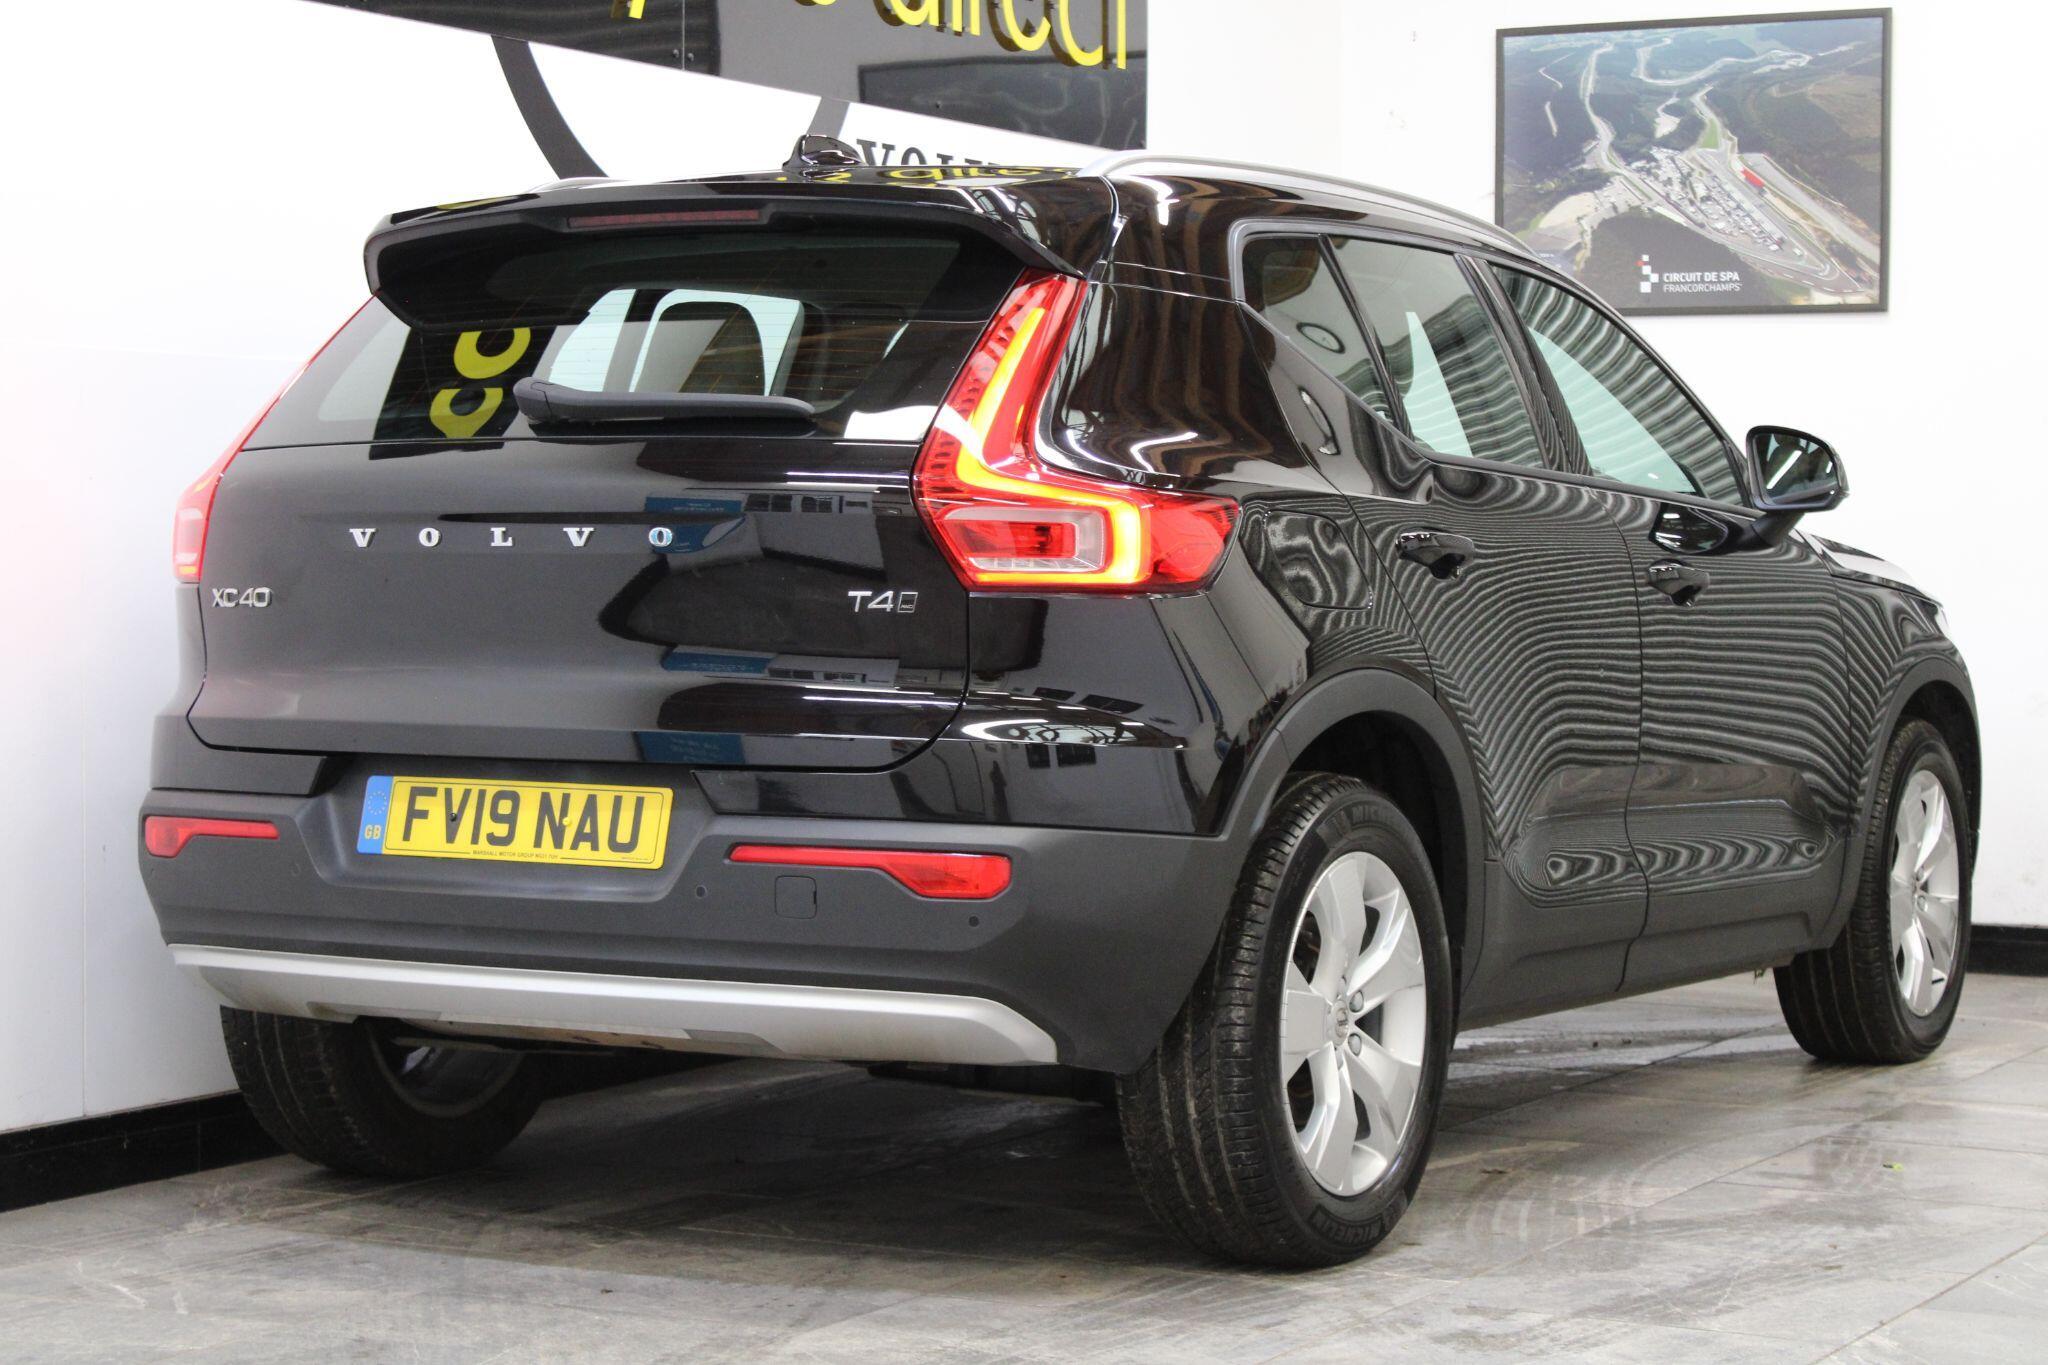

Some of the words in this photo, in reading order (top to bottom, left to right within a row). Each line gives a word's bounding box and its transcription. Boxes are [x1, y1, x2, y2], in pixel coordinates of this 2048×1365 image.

[1663, 272, 1701, 283] CIRCUIT
[1704, 272, 1718, 282] DE
[1720, 272, 1740, 282] SPA
[1663, 283, 1741, 293] FRANCORCHAMPS
[349, 527, 674, 548] VOLVO
[212, 587, 272, 608] XC40
[848, 590, 894, 613] T4
[402, 785, 521, 847] FV19
[533, 790, 646, 854] NAU
[365, 824, 381, 840] GB
